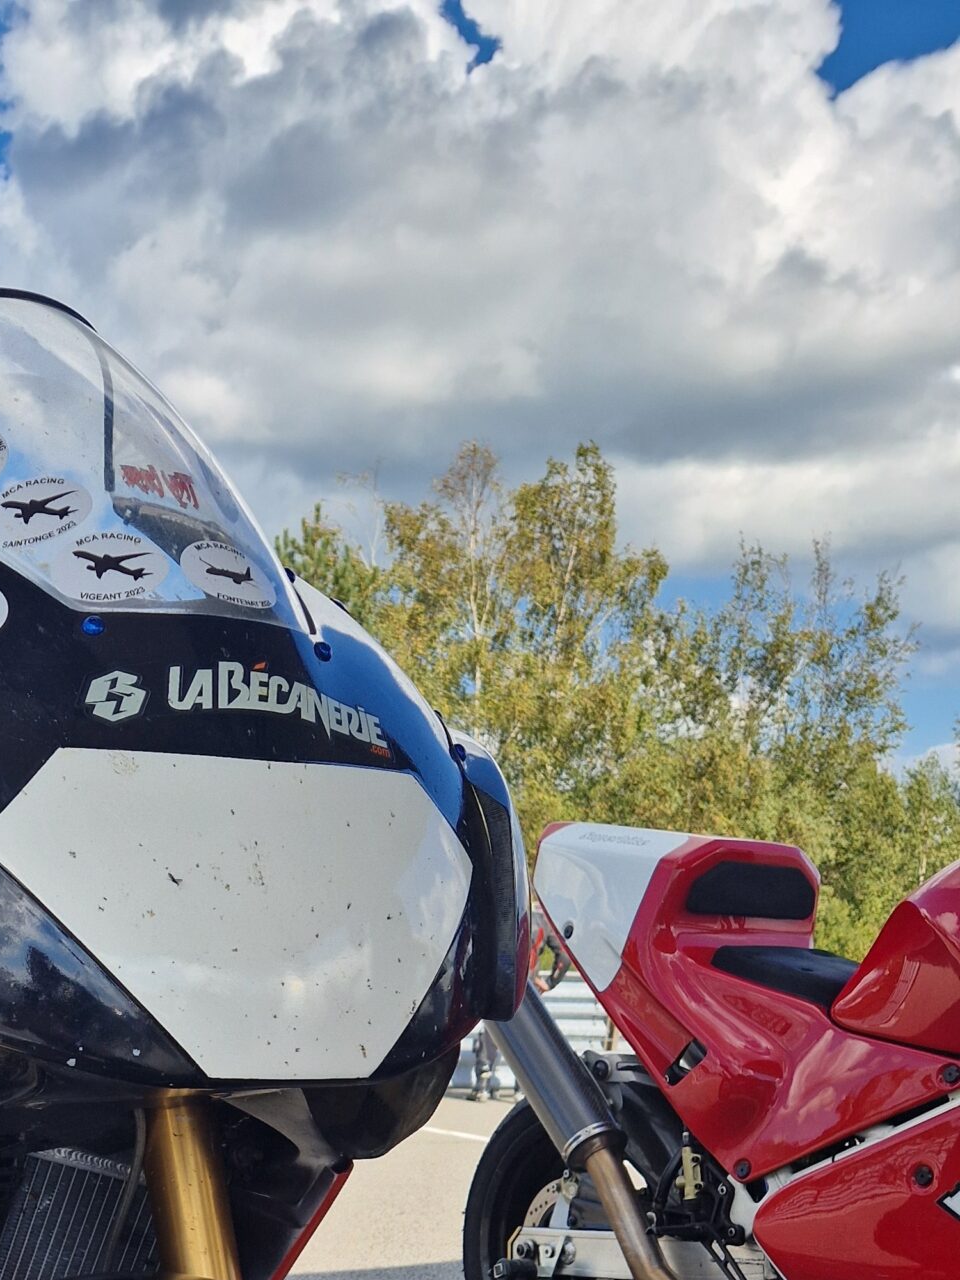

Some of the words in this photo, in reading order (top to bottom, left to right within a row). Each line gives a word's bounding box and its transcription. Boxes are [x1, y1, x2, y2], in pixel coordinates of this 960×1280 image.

[2, 484, 23, 499] MCA
[26, 477, 65, 486] RACING
[2, 531, 56, 549] SAINTONGE
[56, 520, 77, 534] 2023
[76, 534, 99, 547] MCA
[101, 533, 142, 544] RACING
[194, 543, 211, 551] MCA
[80, 592, 122, 601] VIGEANT
[124, 586, 146, 598] 2023
